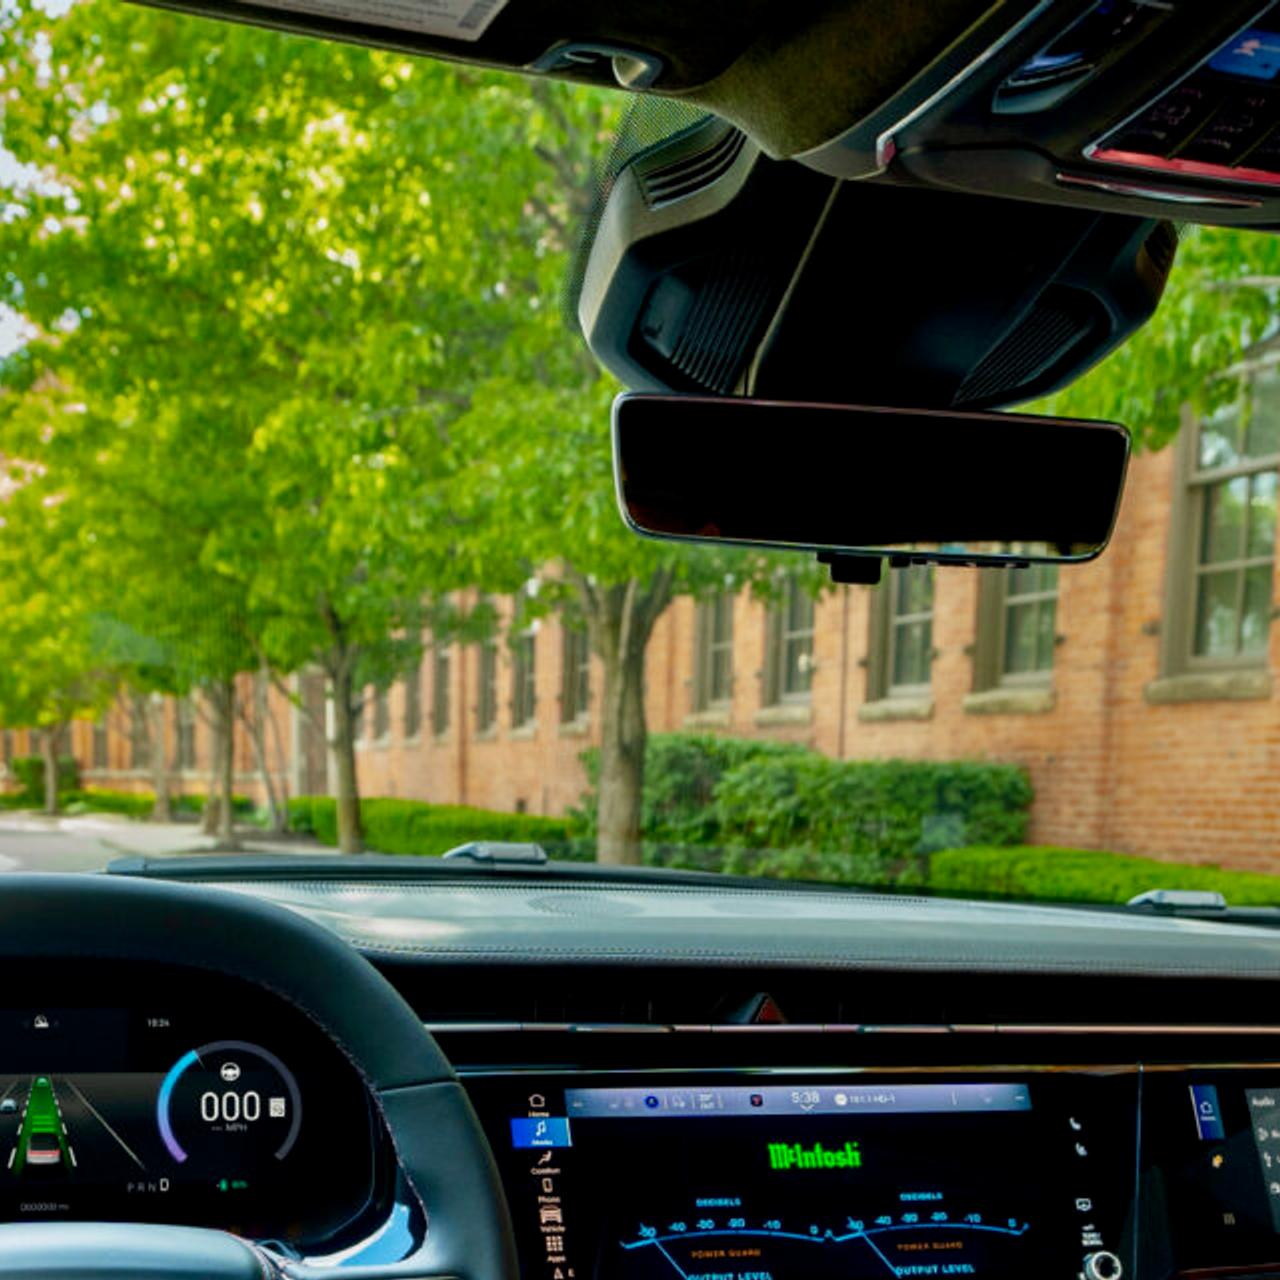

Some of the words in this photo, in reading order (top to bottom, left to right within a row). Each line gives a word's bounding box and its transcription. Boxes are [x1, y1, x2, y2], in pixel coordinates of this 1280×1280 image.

[201, 1091, 261, 1122] 000
[1252, 1096, 1275, 1106] Audio
[768, 1142, 862, 1169] McIntosh
[160, 1178, 169, 1191] D
[695, 1198, 742, 1208] DECIBELS
[547, 1254, 566, 1264] Apps
[896, 1264, 938, 1276] OUTPUT
[941, 1264, 975, 1274] LEVEL
[737, 1272, 773, 1280] LEVEL
